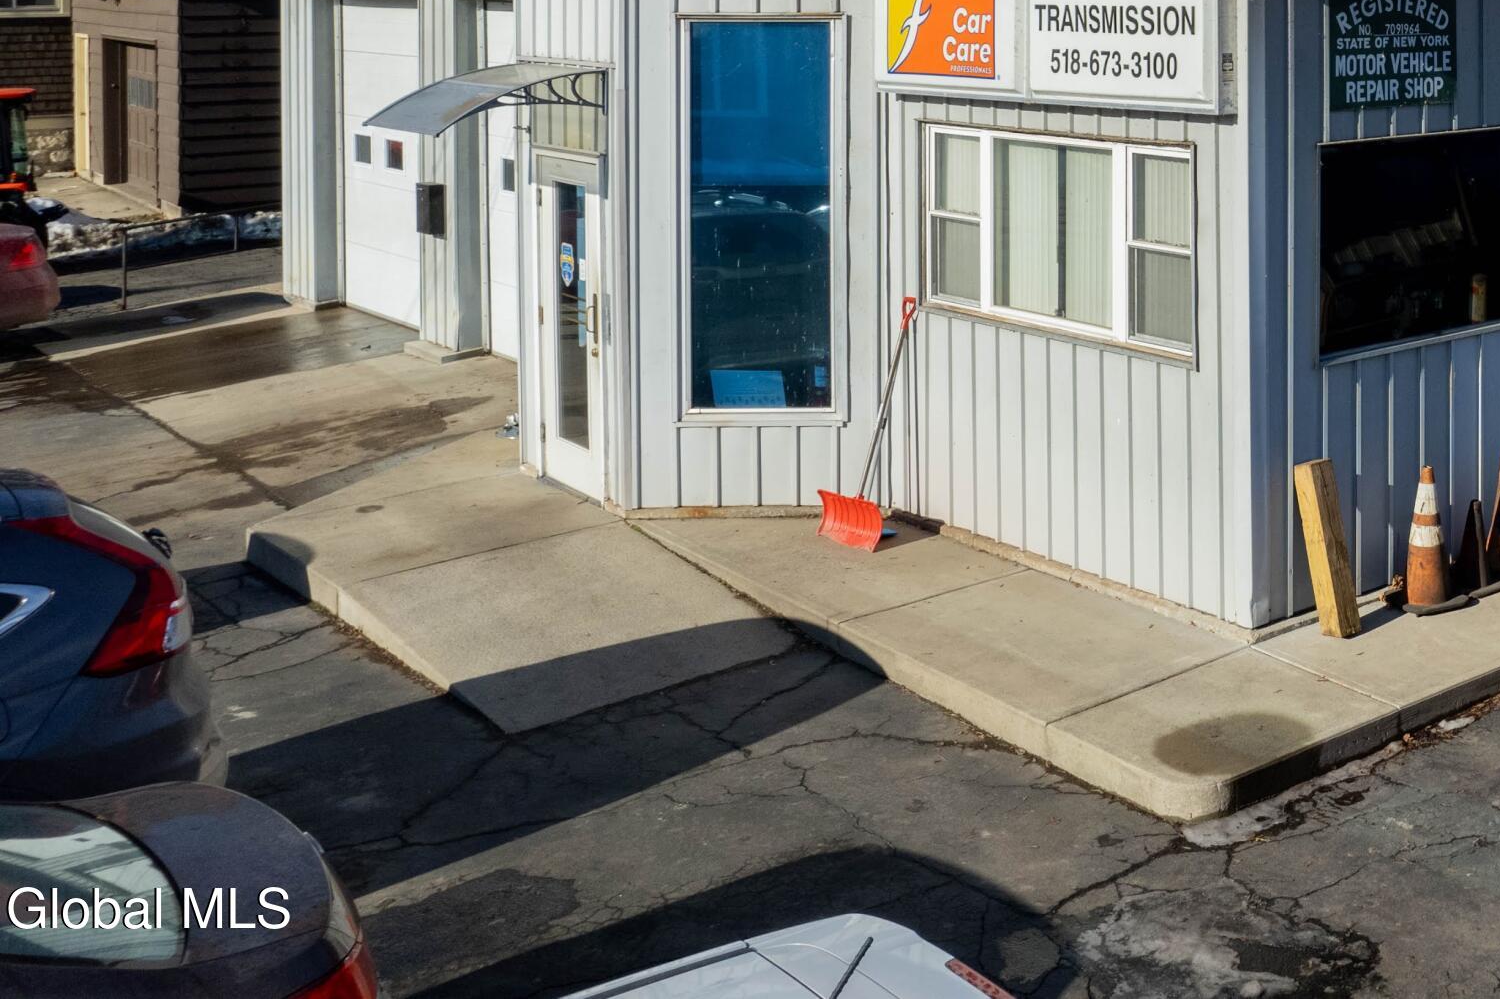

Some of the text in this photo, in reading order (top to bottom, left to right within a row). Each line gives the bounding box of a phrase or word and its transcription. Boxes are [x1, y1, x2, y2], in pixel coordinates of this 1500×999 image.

[952, 6, 992, 34] Car
[1034, 4, 1196, 35] TRANSMISSION
[942, 36, 991, 63] Care
[1336, 35, 1449, 50] STATE OF NEW YORK
[950, 65, 992, 74] PROFESSIONALS
[1050, 48, 1177, 80] 518-673-3100
[1335, 51, 1452, 77] MOTOR VEHICLE
[1346, 77, 1444, 103] REPAIR SHOP
